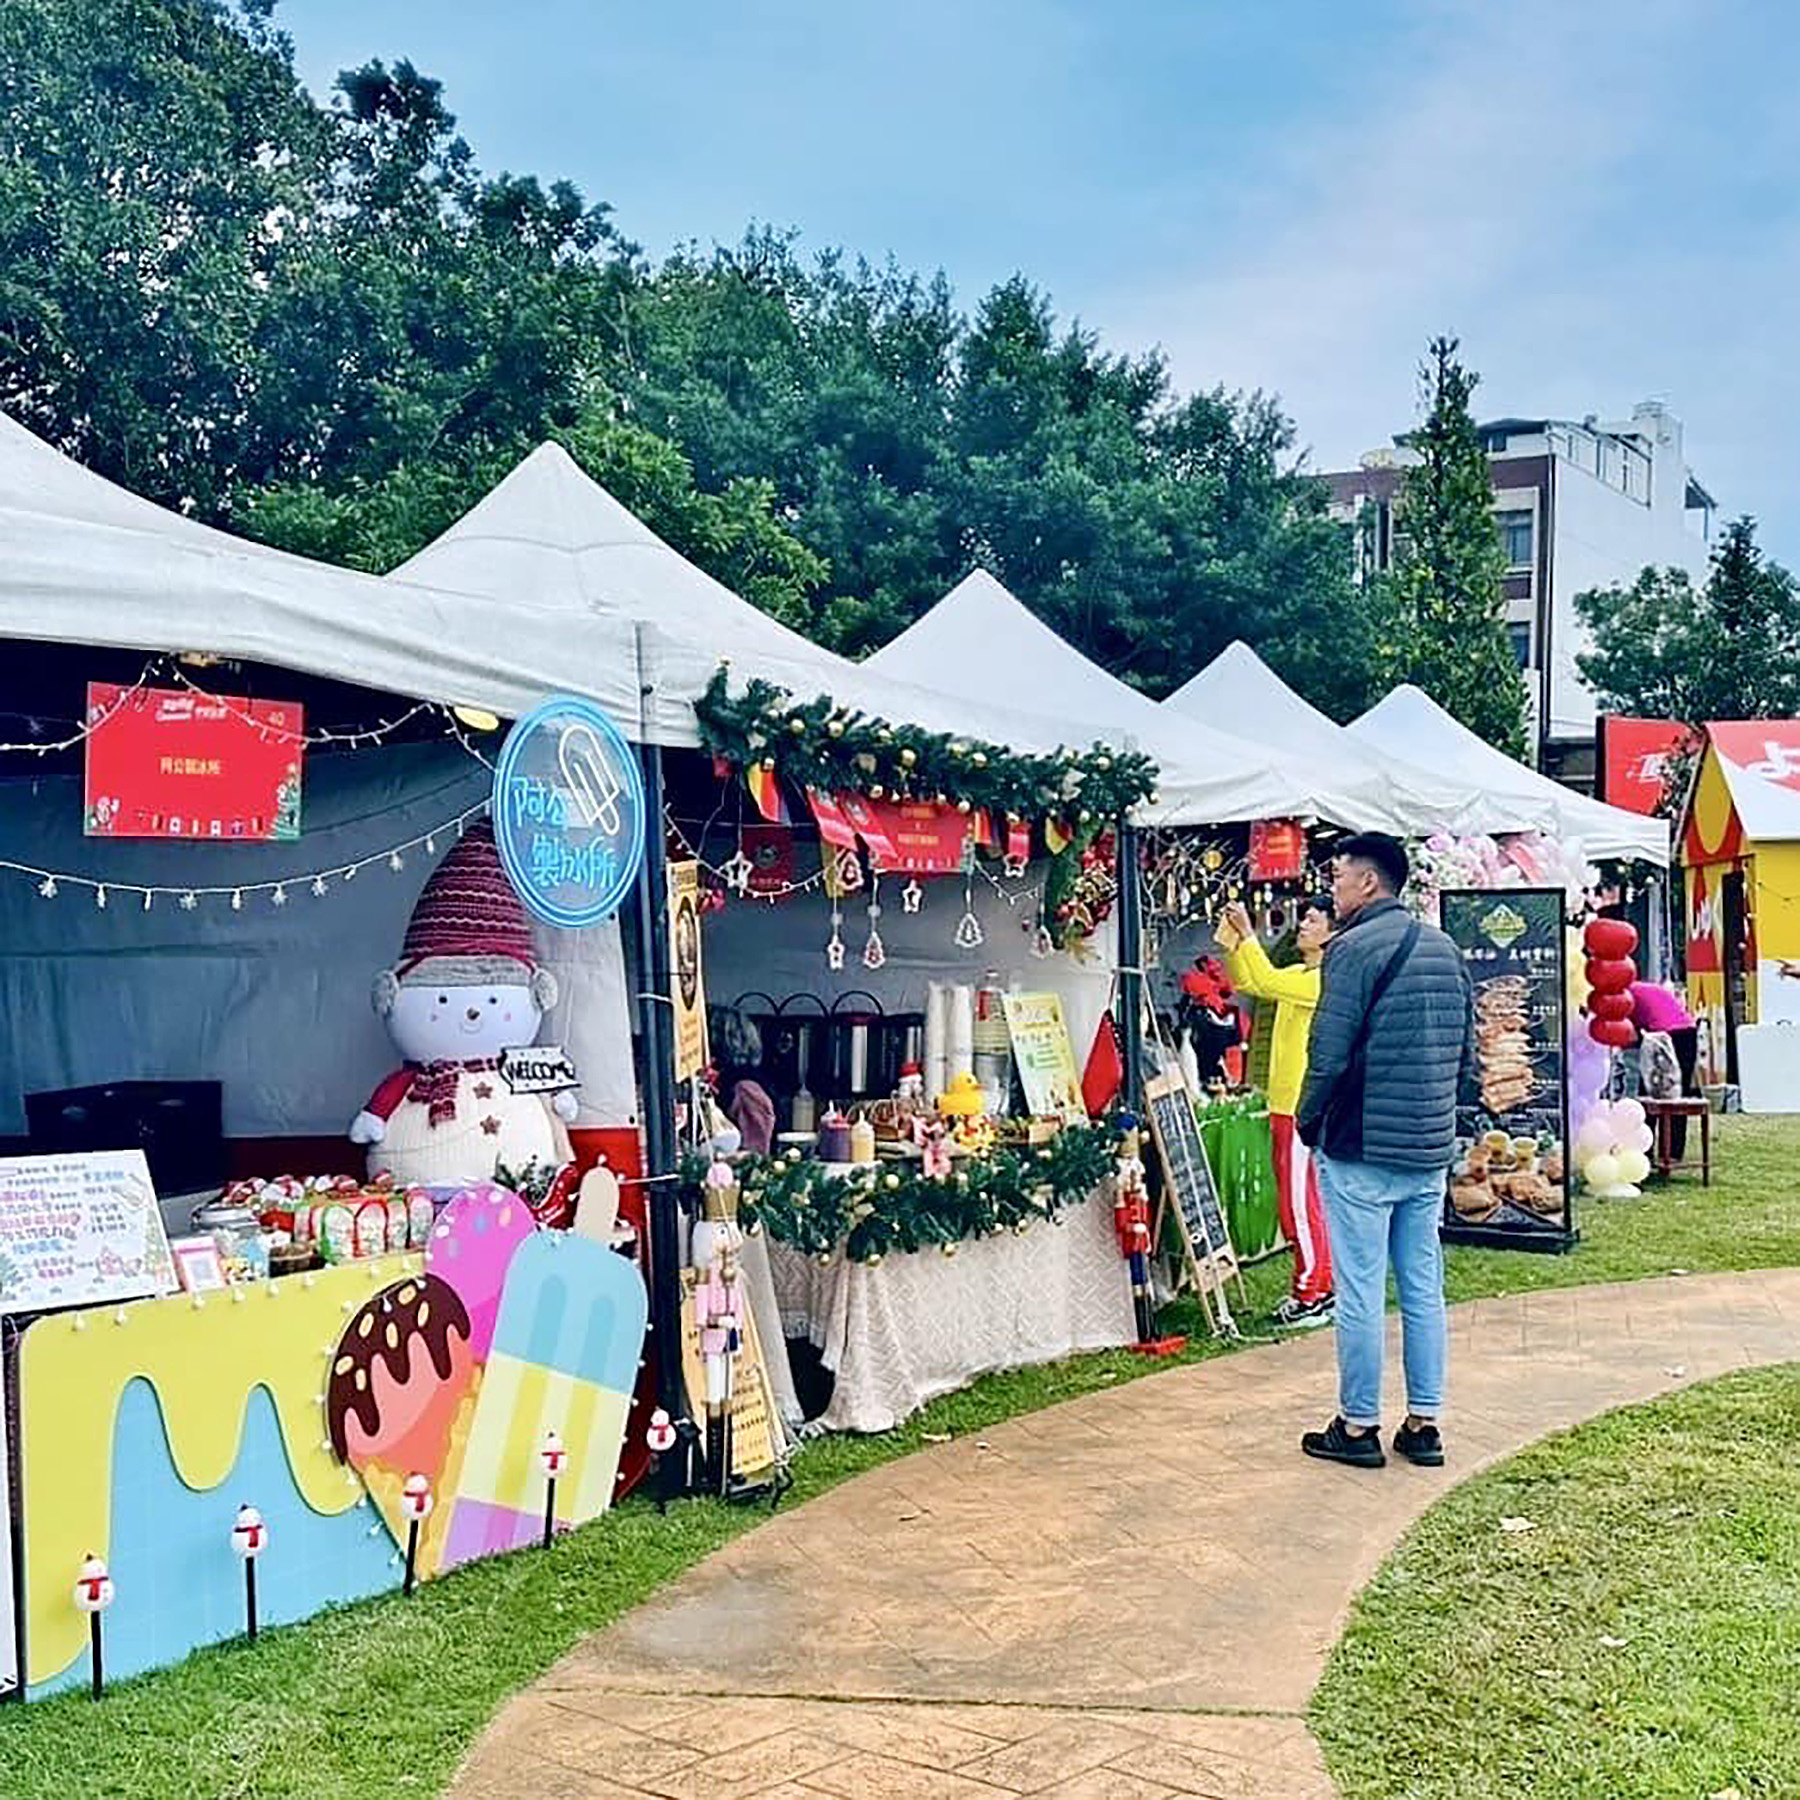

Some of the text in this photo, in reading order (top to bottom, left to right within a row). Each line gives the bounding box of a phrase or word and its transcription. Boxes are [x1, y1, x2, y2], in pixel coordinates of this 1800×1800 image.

[510, 777, 567, 829] 阿公
[532, 833, 617, 888] 製冰所
